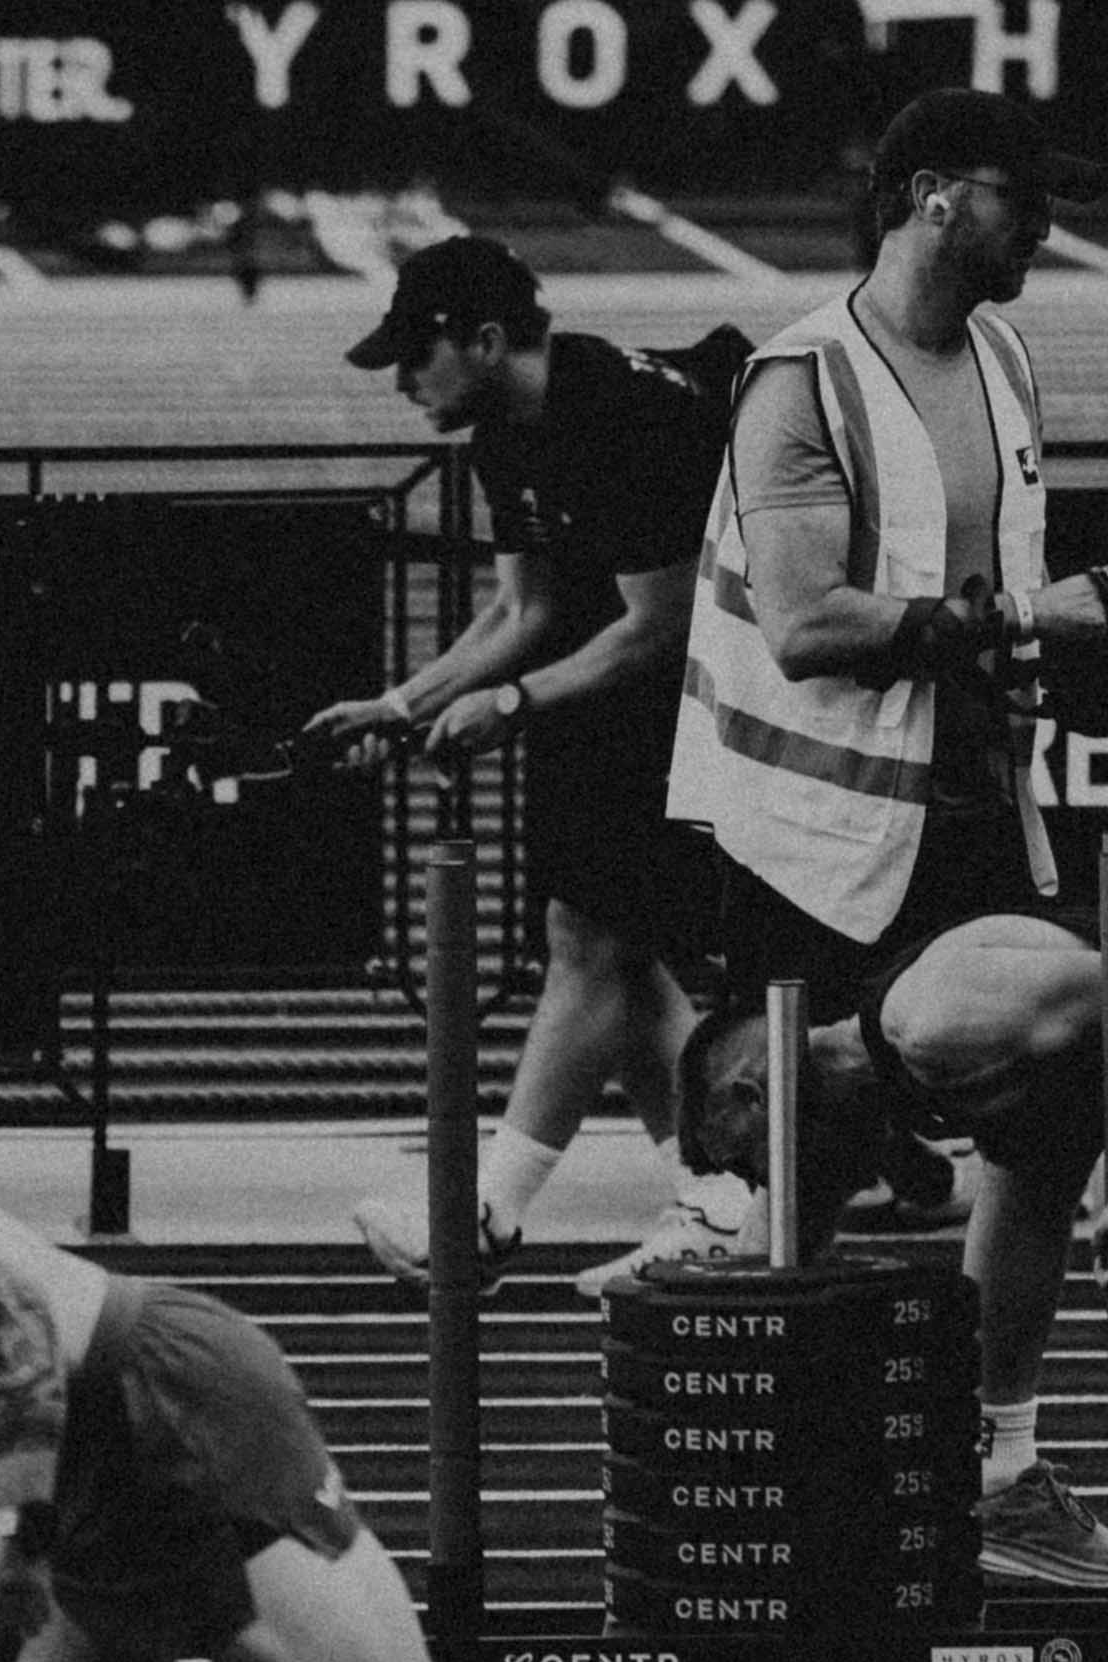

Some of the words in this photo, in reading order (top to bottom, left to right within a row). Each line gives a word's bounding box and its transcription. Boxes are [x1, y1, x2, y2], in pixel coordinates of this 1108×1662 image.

[672, 1315, 786, 1337] CENTR
[663, 1372, 775, 1395] CENTR
[663, 1428, 775, 1451] CENTR
[672, 1485, 785, 1508] CENTR
[677, 1542, 791, 1565] CENTR
[674, 1598, 788, 1621] CENTR
